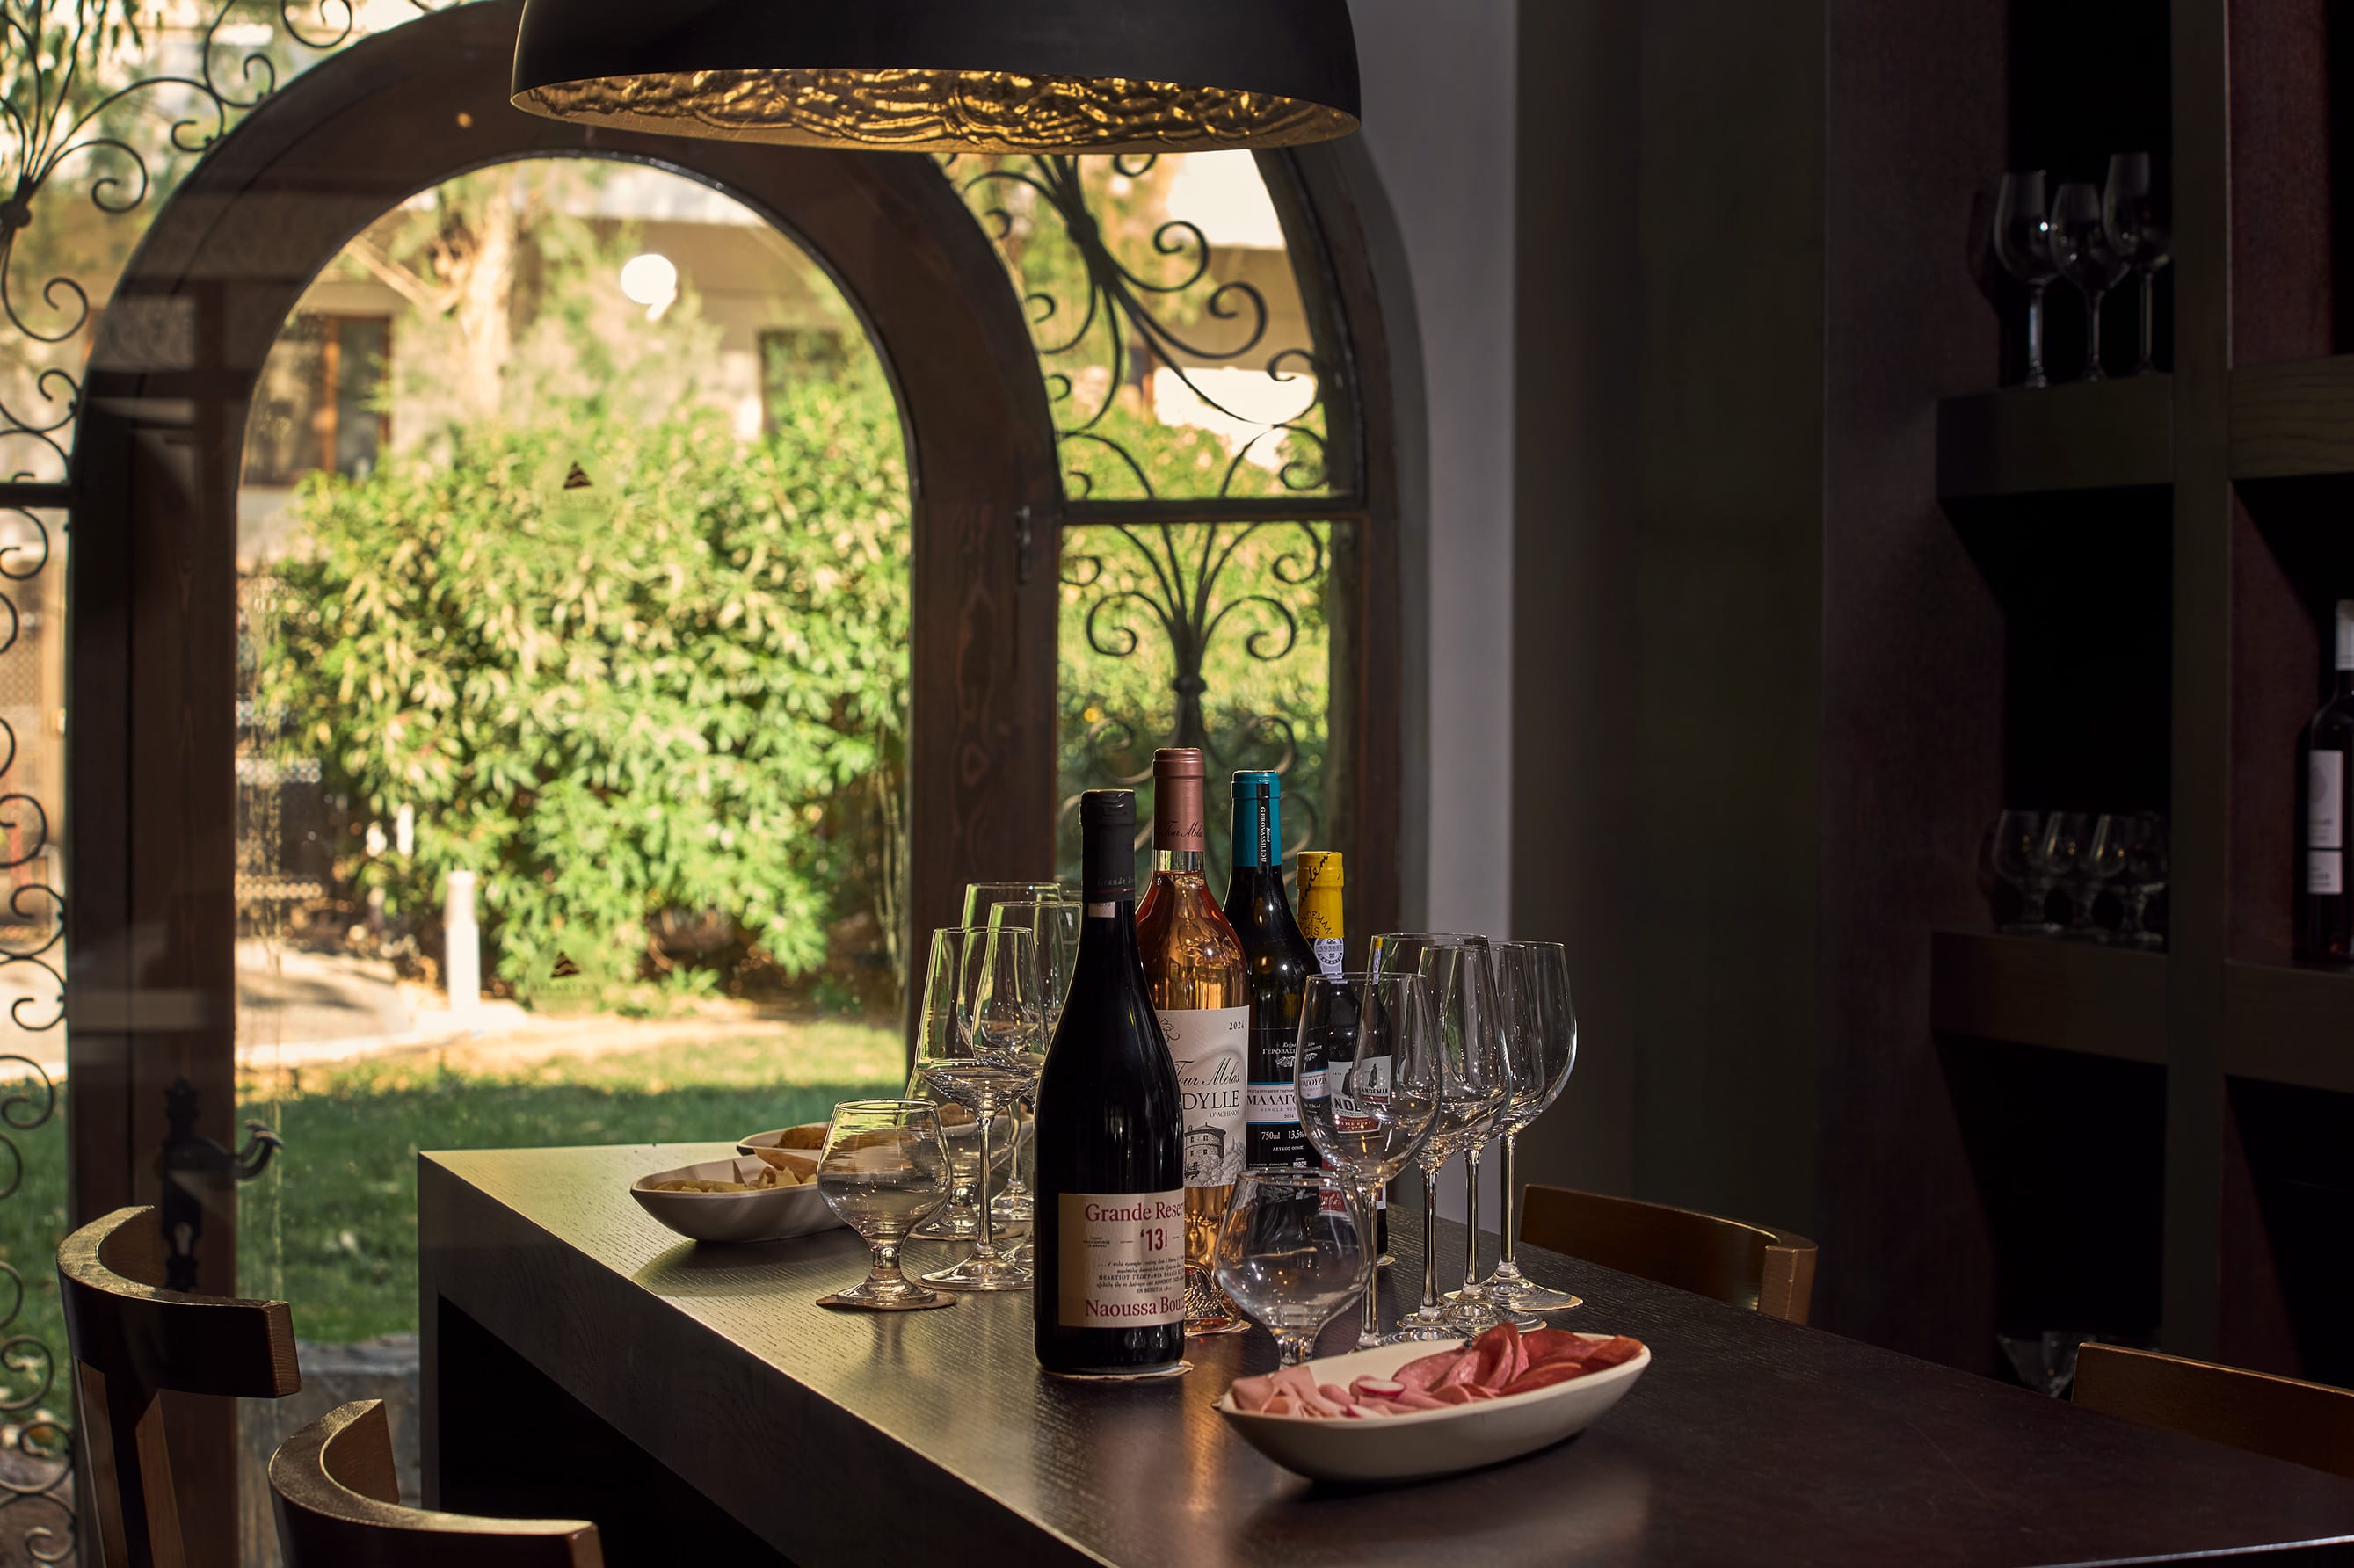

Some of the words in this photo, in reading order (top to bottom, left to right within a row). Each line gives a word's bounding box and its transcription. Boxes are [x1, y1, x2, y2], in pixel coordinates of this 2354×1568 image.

[1228, 1020, 1245, 1031] 2024
[1202, 1057, 1240, 1086] Melas
[1181, 1089, 1240, 1111] DYLLE
[1261, 1131, 1281, 1141] 750ml
[1085, 1201, 1152, 1222] Grande
[1155, 1201, 1184, 1220] Reser
[1085, 1299, 1157, 1317] Naoussa
